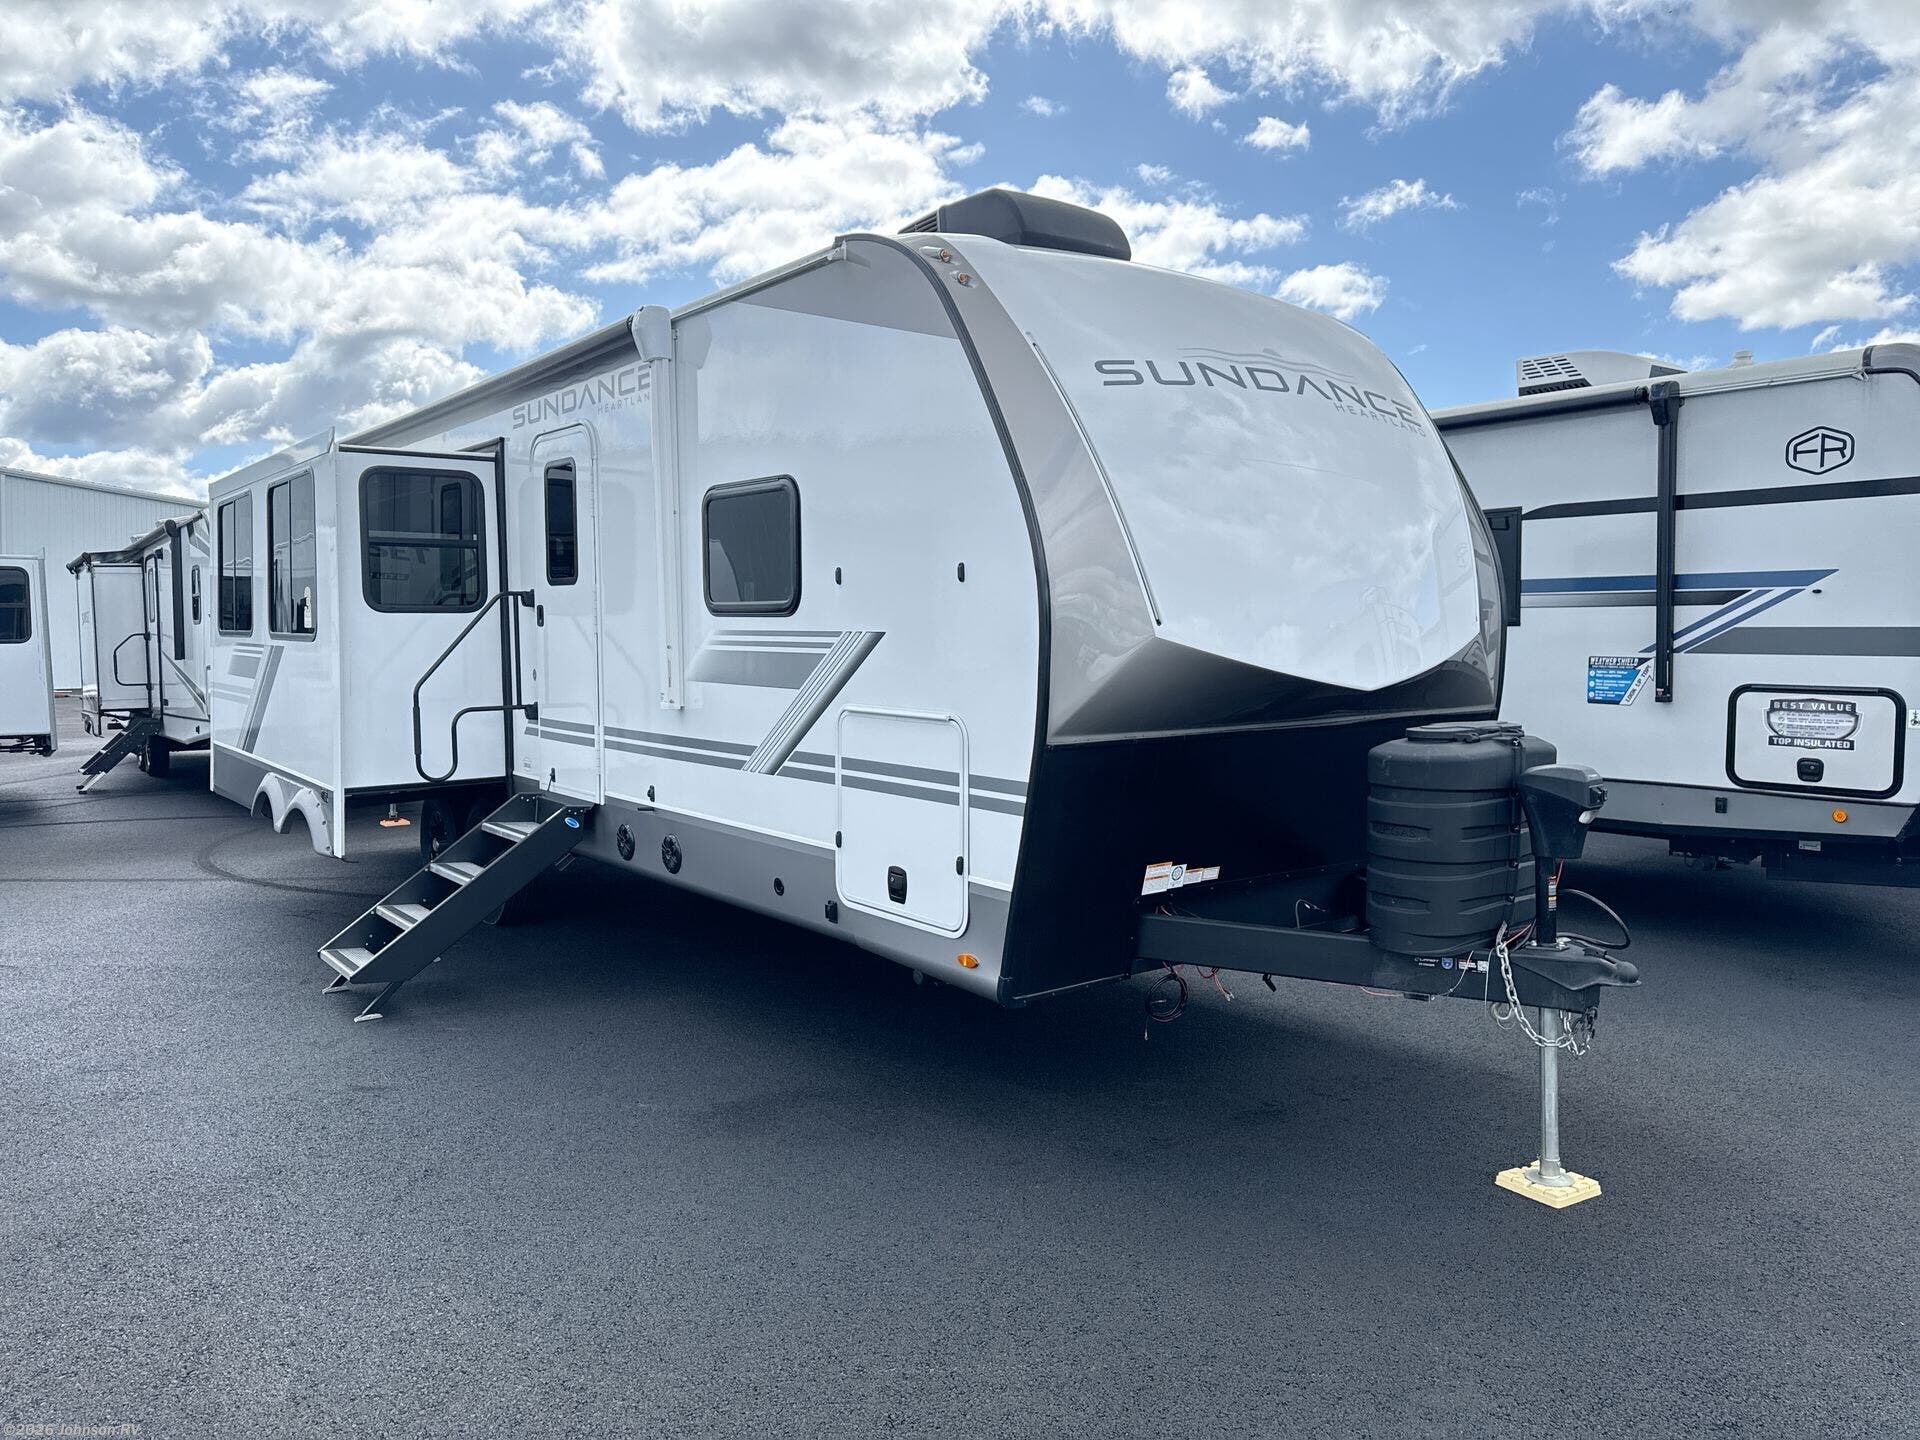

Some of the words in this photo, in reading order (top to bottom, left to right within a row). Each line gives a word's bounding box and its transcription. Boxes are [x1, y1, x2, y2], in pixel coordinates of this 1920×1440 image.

[512, 364, 650, 430] SUNDANCE
[1094, 359, 1422, 428] SUNDANCE
[1793, 433, 1847, 468] FR
[1773, 701, 1804, 710] BEST
[1811, 702, 1852, 712] VALUE
[1772, 737, 1791, 745] TOP
[1793, 739, 1851, 748] INSULATED
